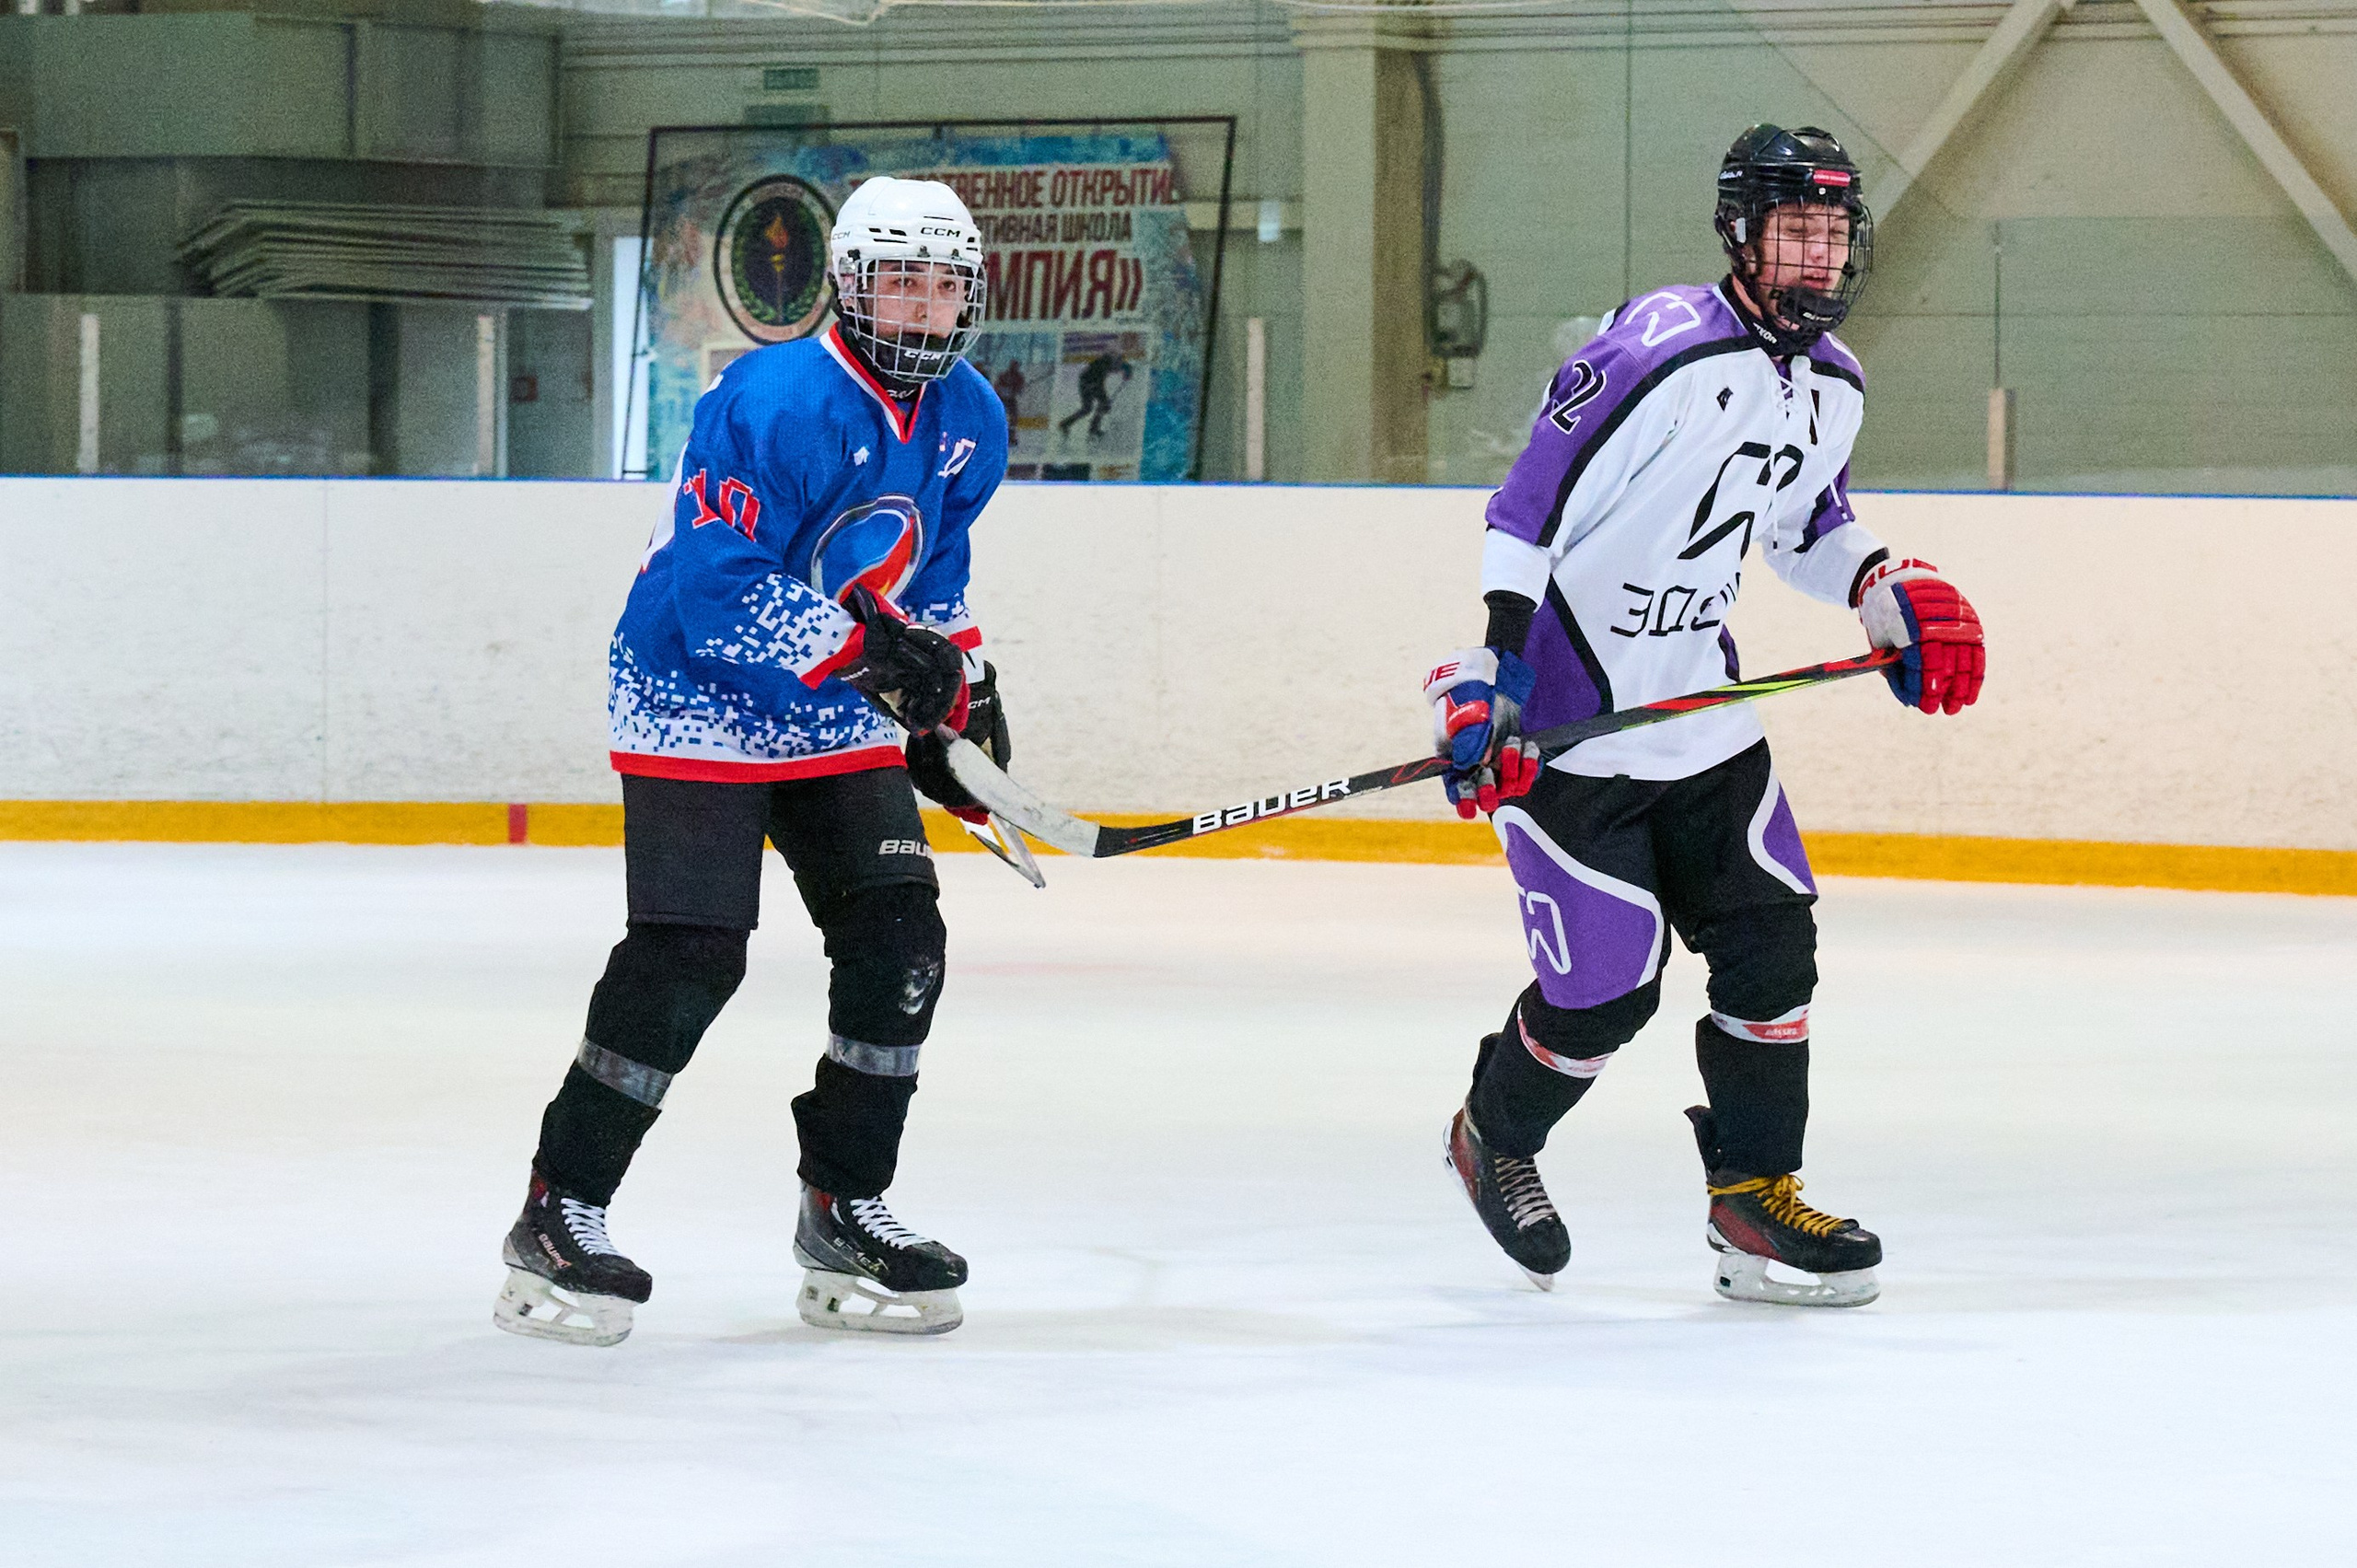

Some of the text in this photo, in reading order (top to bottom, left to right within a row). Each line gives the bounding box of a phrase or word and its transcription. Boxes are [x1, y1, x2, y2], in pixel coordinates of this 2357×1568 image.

[832, 230, 851, 240] CCM
[921, 226, 961, 238] CCM
[968, 696, 992, 709] CM
